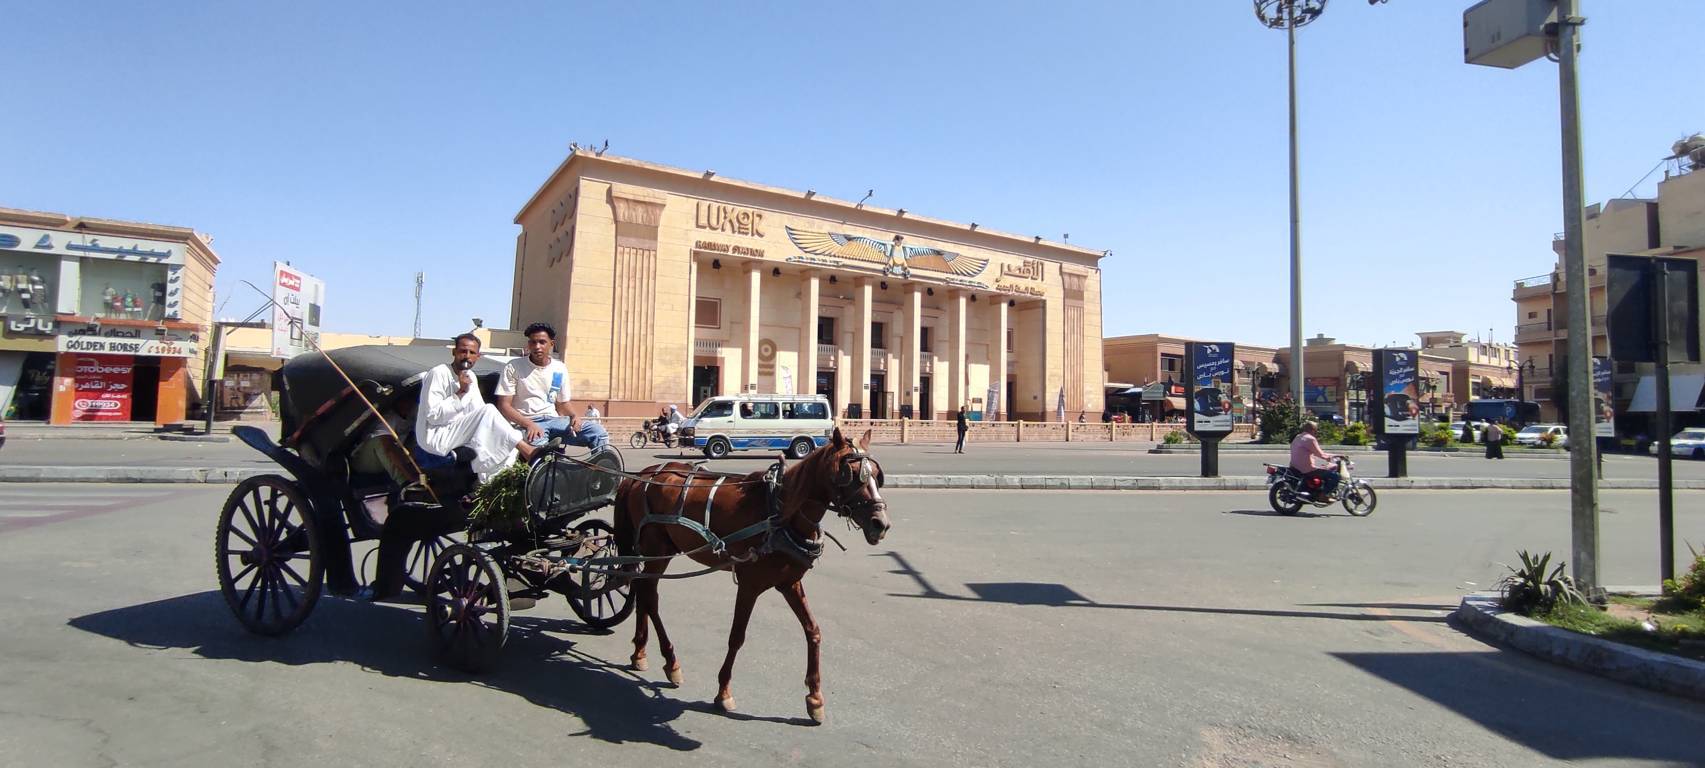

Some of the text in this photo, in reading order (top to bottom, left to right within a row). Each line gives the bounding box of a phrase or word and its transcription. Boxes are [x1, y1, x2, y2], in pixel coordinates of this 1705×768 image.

[695, 201, 765, 238] LUXOR
[732, 245, 765, 257] STATION
[66, 340, 140, 353] GOLDEN HORSE
